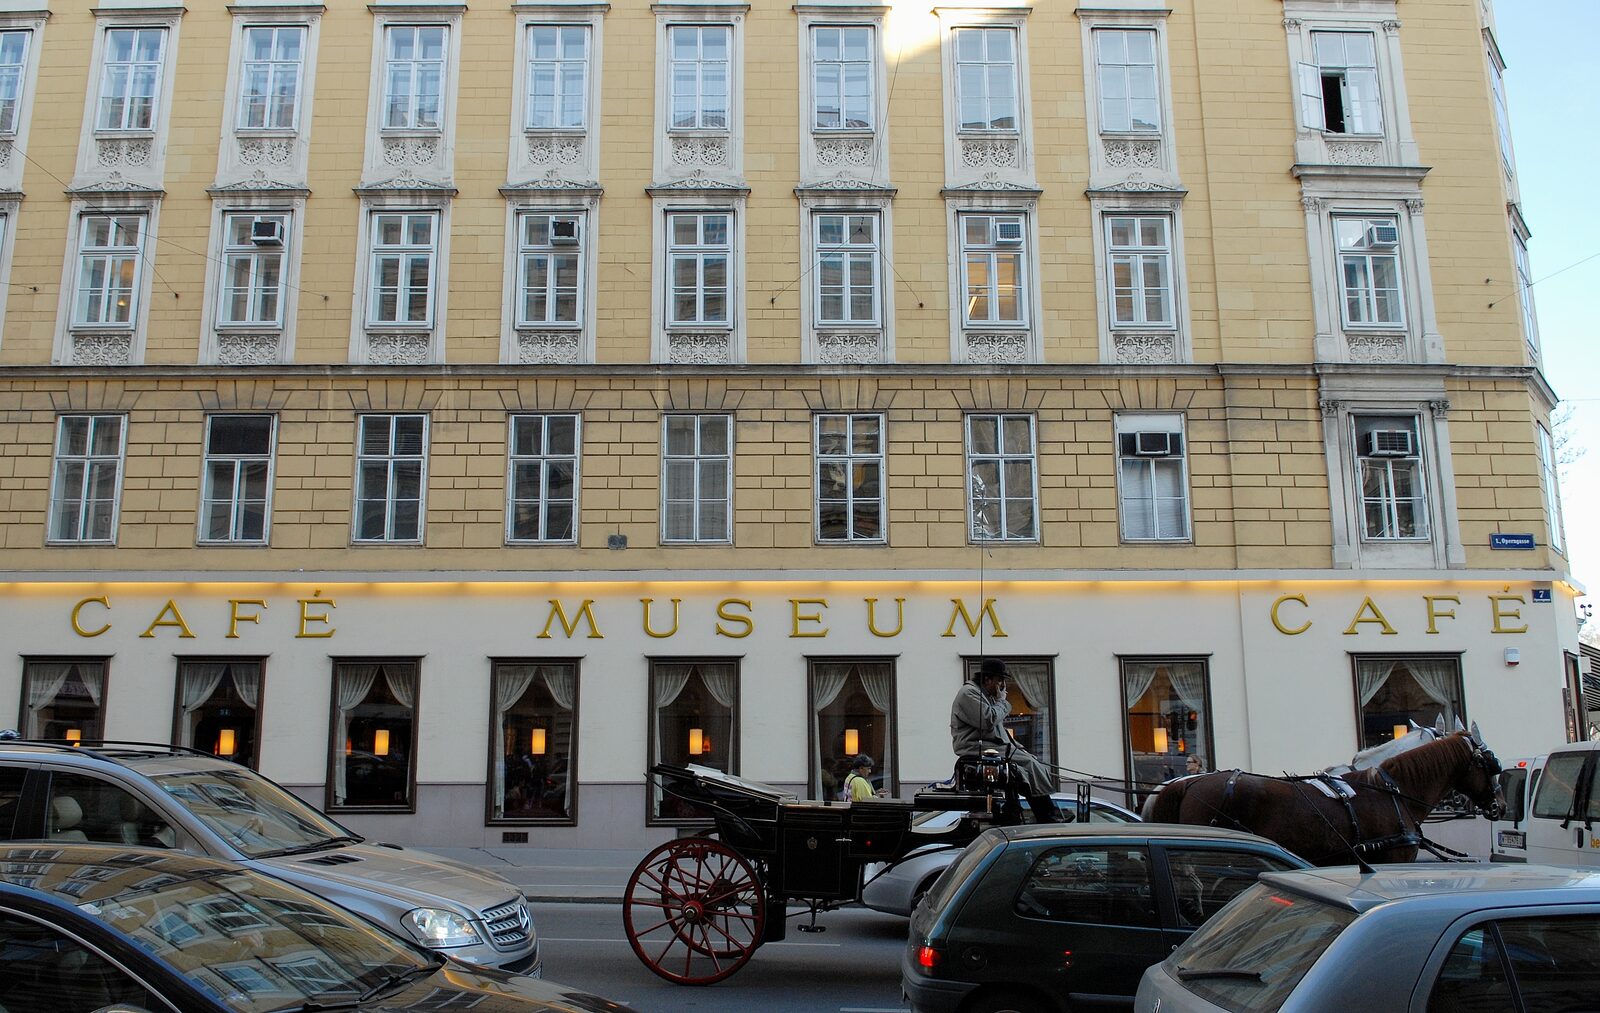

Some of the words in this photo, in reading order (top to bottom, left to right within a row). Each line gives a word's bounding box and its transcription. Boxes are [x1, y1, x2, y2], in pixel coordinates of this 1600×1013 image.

[1501, 537, 1530, 545] Operngasse
[71, 589, 338, 639] CAFÉ
[537, 597, 1008, 639] MUSEUM
[1270, 585, 1529, 635] CAFÉ
